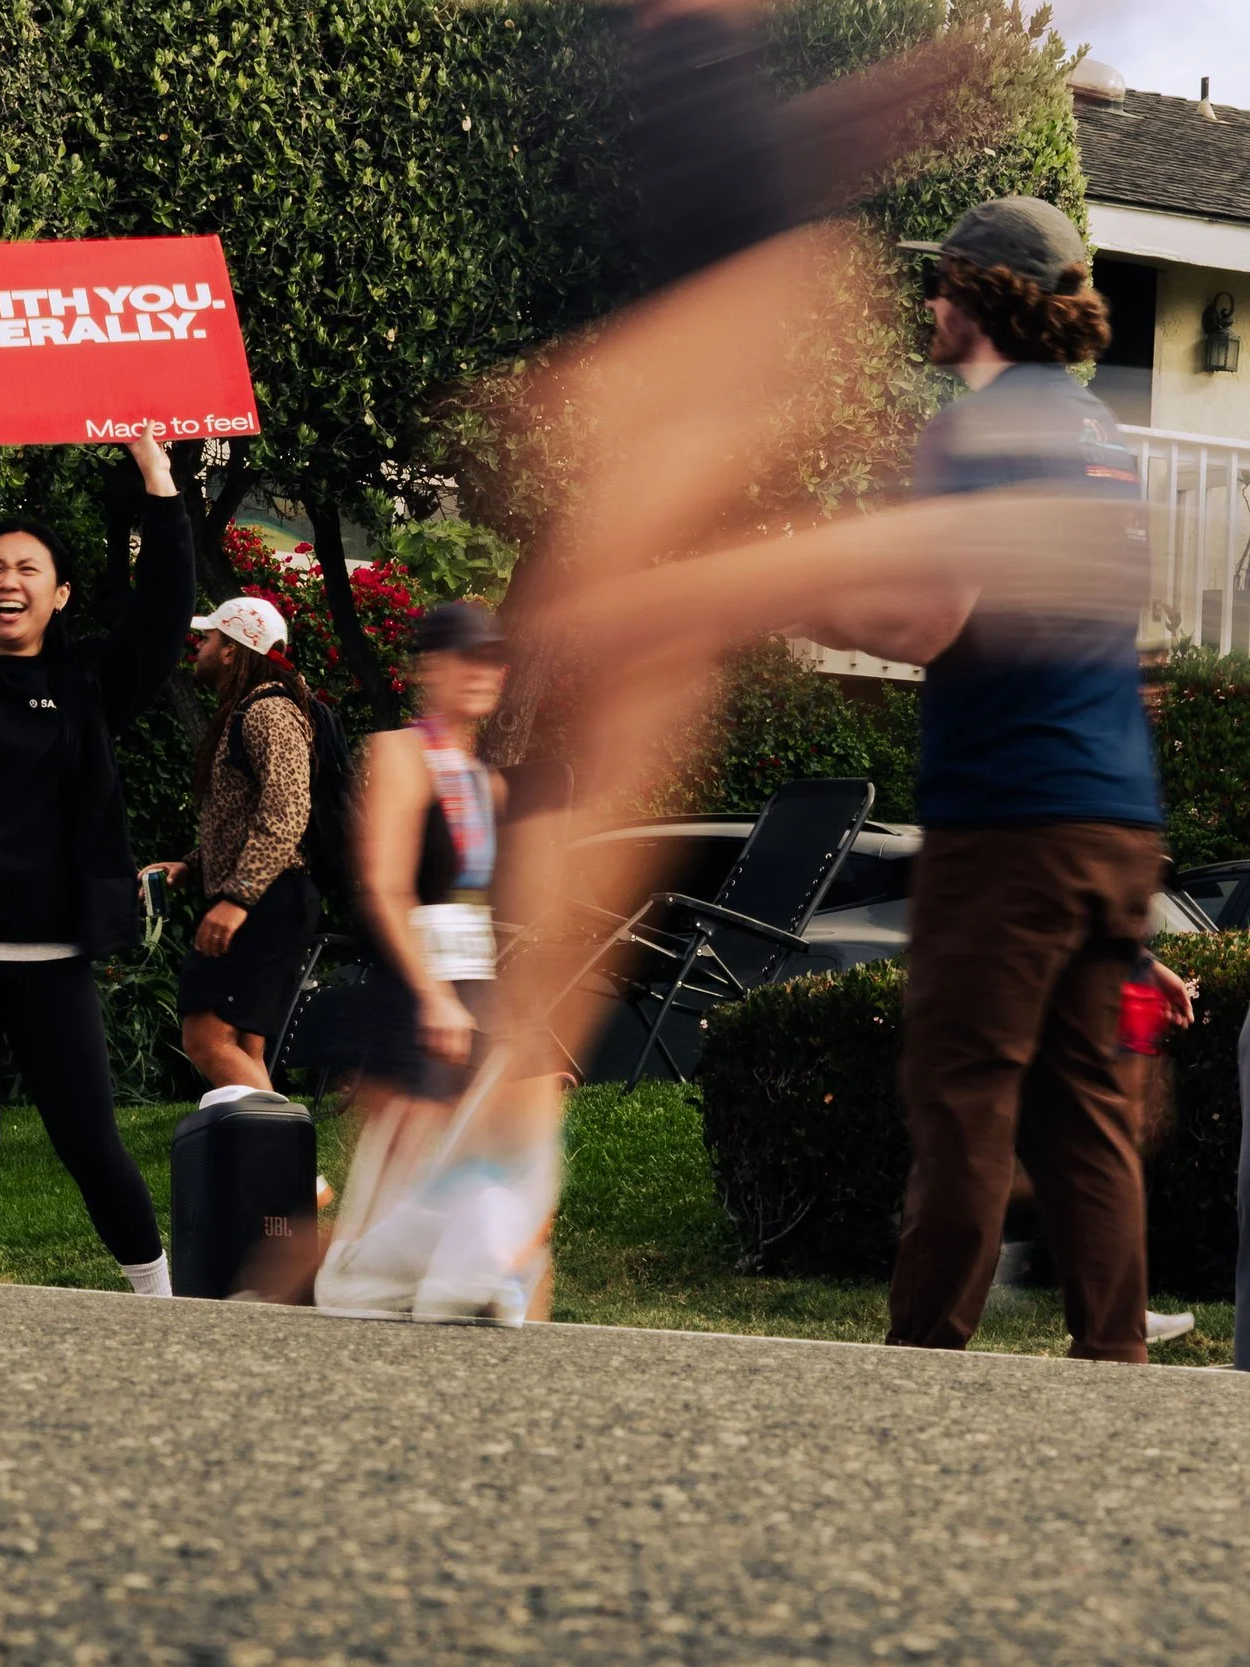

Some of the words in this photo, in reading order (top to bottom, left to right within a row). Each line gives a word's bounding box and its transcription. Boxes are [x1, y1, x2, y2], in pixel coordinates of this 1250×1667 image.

[93, 283, 226, 314] YOU.
[85, 417, 166, 438] Made
[170, 416, 199, 435] to
[204, 412, 254, 433] feel
[263, 1216, 292, 1237] JBL
